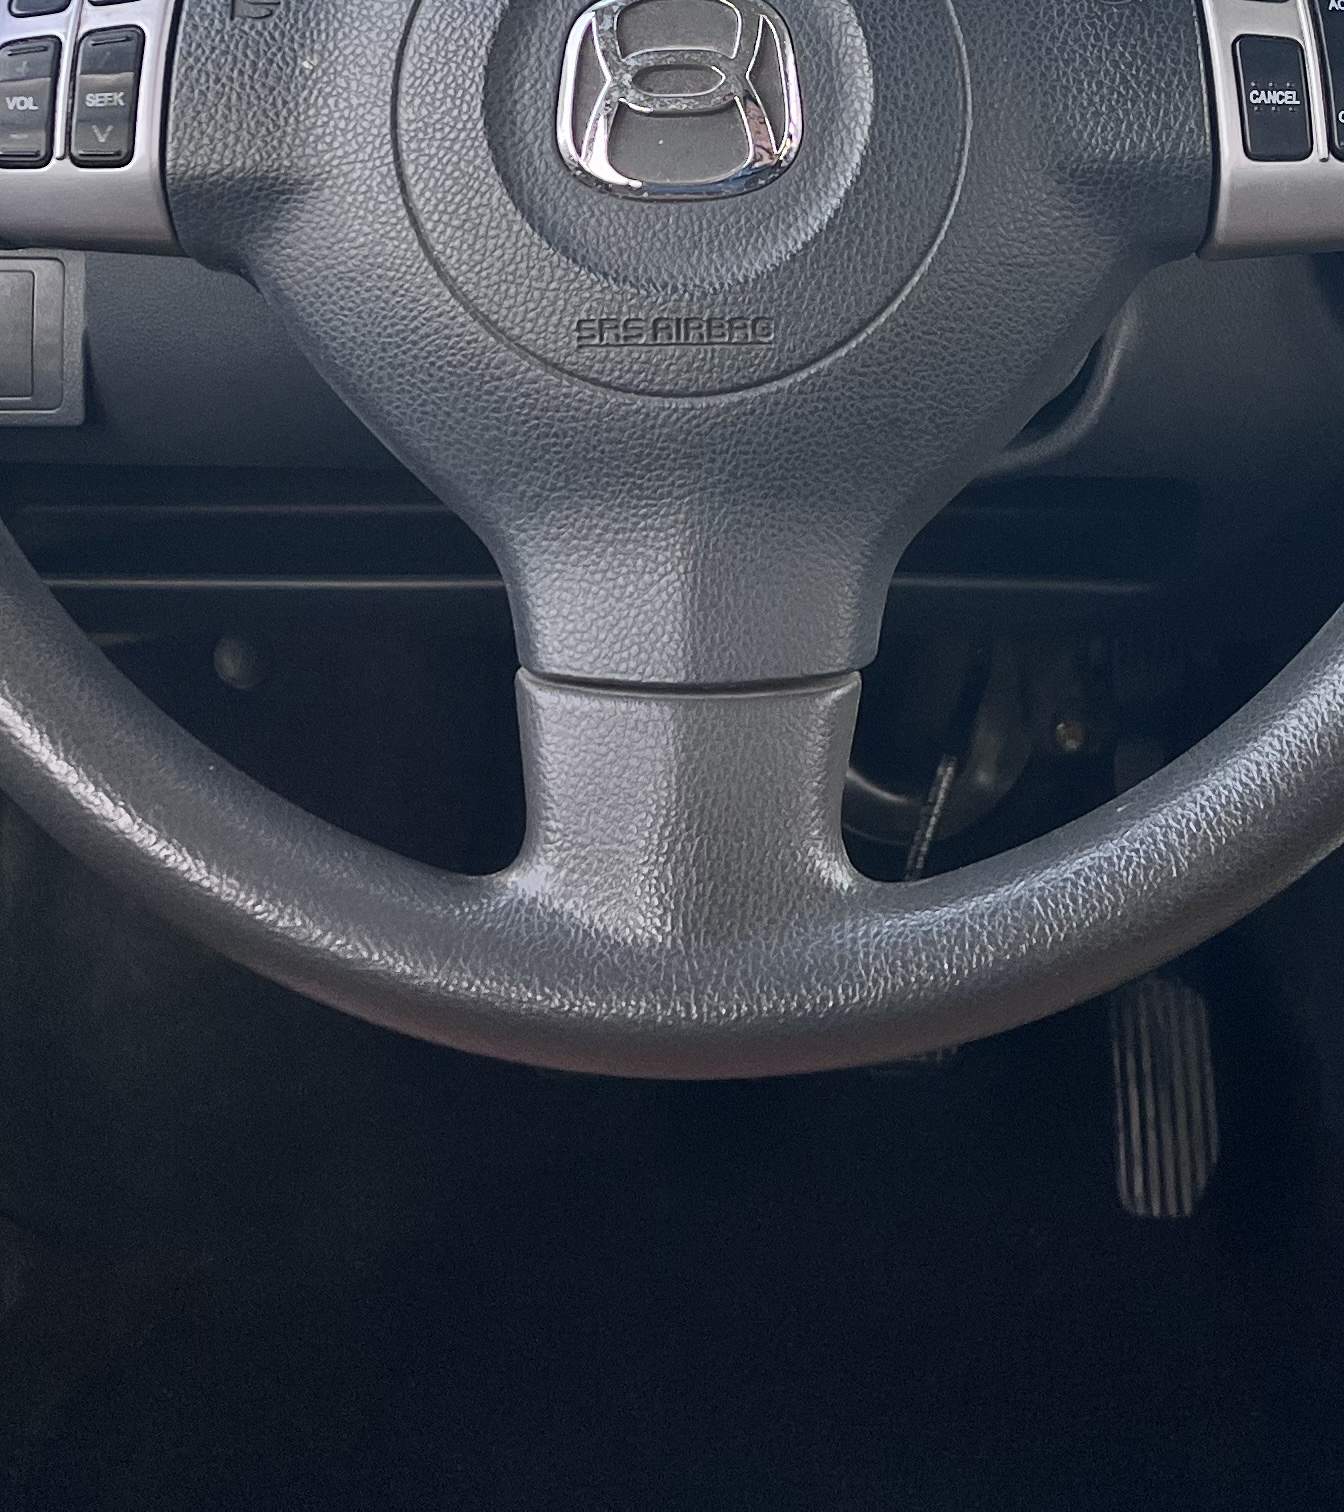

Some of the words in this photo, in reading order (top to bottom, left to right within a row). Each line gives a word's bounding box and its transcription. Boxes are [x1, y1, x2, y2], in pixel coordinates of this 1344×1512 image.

[6, 95, 38, 111] VOL
[85, 91, 125, 108] SEEK
[1249, 89, 1301, 105] CANCEL
[576, 317, 645, 345] SRS
[652, 317, 775, 345] AIRBAG
